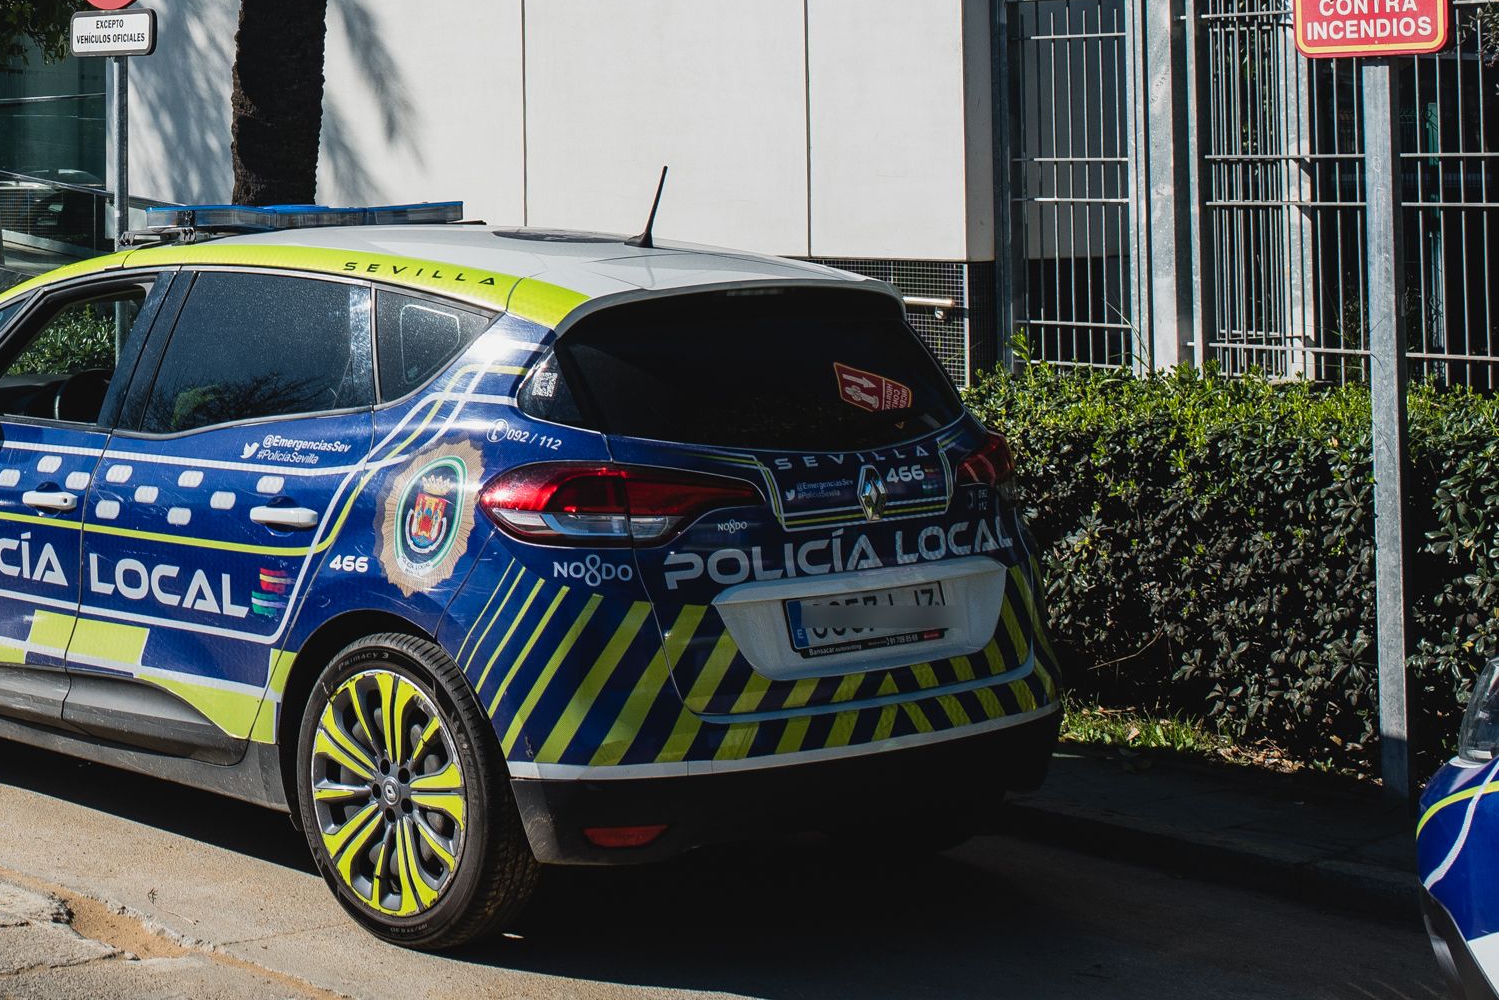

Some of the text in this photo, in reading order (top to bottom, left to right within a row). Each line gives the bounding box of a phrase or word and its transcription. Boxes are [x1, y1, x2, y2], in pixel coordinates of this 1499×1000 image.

[95, 19, 124, 29] EXCEPTO
[1306, 16, 1432, 41] INCENDIOS
[76, 31, 145, 45] VEHÍCULOS OFICIALES
[343, 262, 495, 286] SEVILLA
[262, 434, 352, 453] @EmergenciasSev
[506, 428, 530, 444] 092
[539, 435, 562, 451] 112
[773, 445, 930, 471] SEVILLA
[886, 465, 926, 483] 466
[329, 554, 369, 573] 466
[662, 515, 1013, 591] POLICÍA LOCAL
[89, 553, 250, 619] LOCAL
[338, 651, 390, 671] PRIMACY 3
